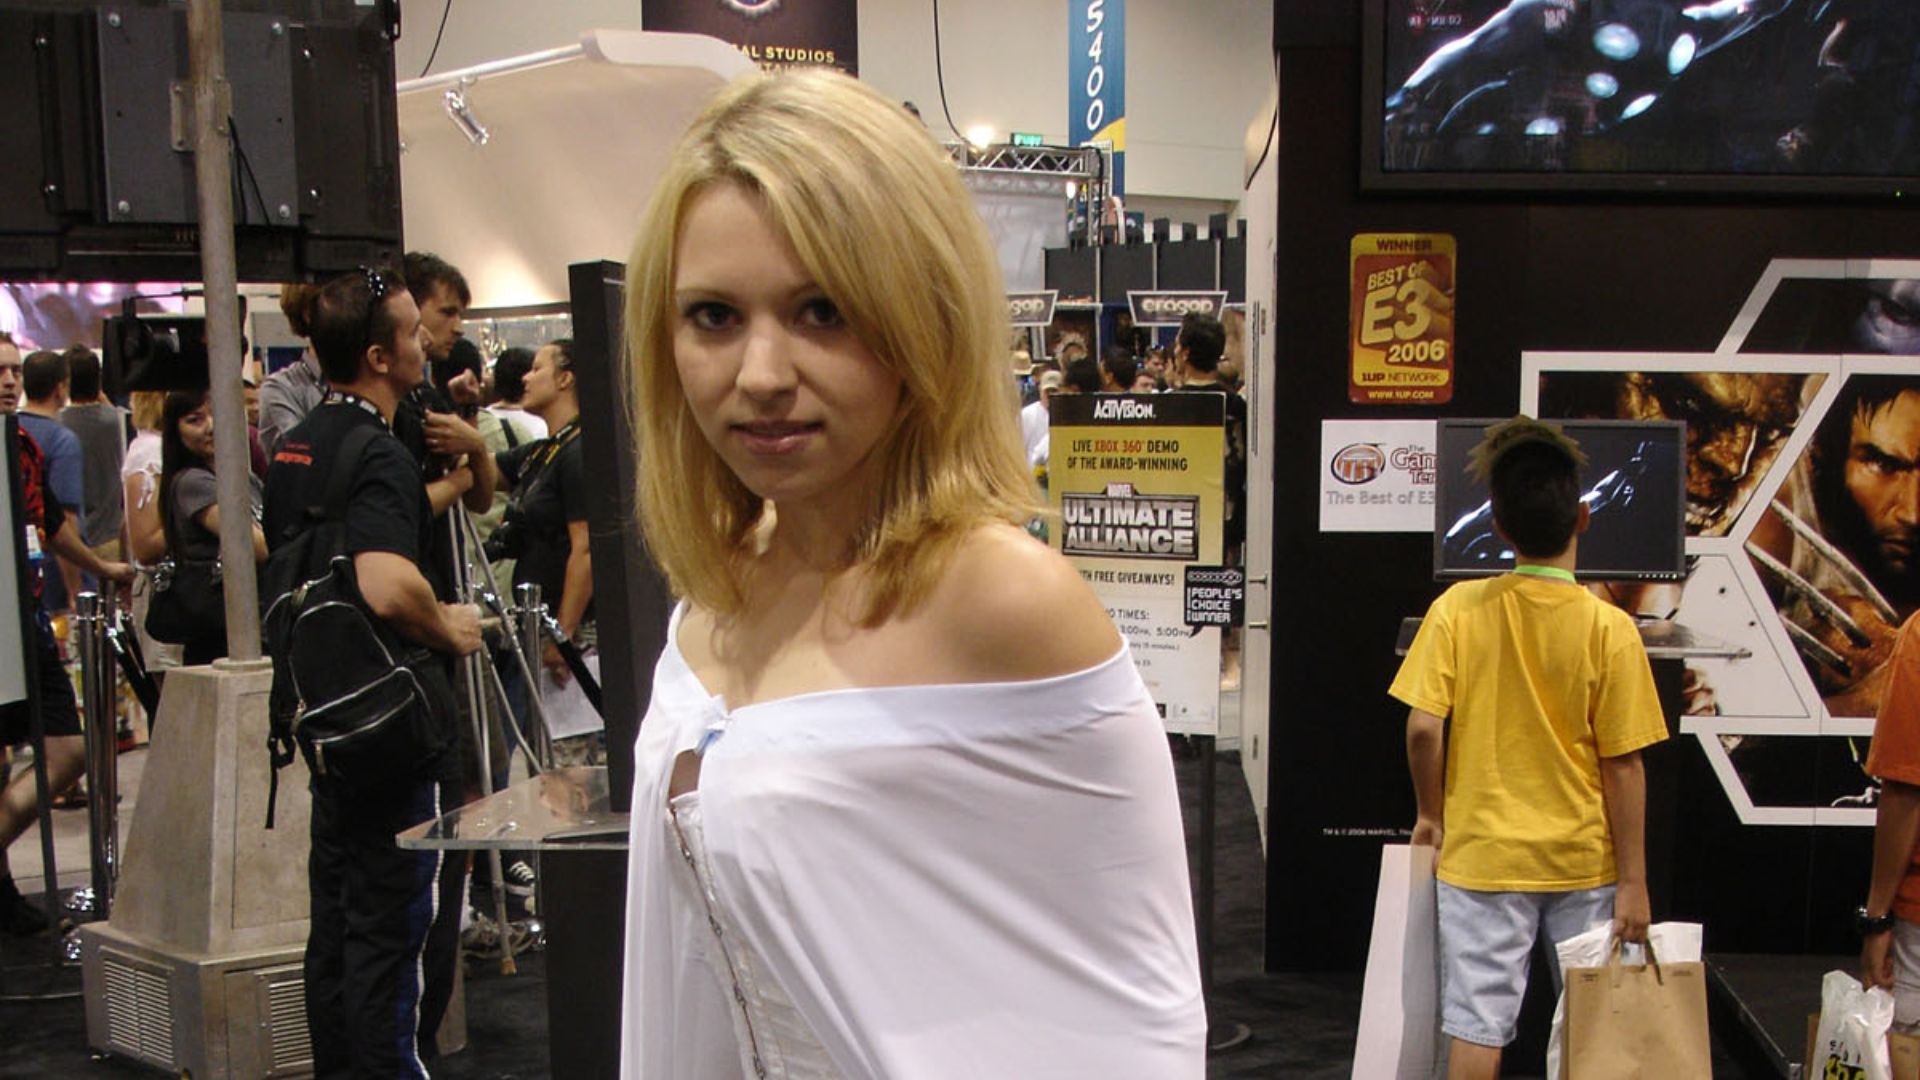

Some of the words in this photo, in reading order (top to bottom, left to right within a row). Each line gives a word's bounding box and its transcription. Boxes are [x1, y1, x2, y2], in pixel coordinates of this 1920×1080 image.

[766, 46, 836, 63] STUDIOS
[1376, 239, 1432, 251] WINNER
[1367, 265, 1406, 291] BEST
[1361, 279, 1432, 345] E3
[1387, 339, 1446, 362] 2006
[1362, 373, 1385, 382] 1UP
[1073, 440, 1092, 453] LIVE
[1094, 440, 1119, 453] XBOX
[1147, 440, 1180, 453] DEMO
[1067, 456, 1077, 468] OF
[1081, 457, 1097, 469] THE
[1100, 457, 1189, 471] AWARD-WINNING
[1326, 491, 1355, 504] The
[1359, 491, 1393, 504] Best
[1397, 491, 1413, 504] of
[1065, 499, 1194, 528] ULTIMATE
[1066, 525, 1195, 554] ALLIANCE
[1094, 570, 1114, 583] FREE
[1118, 572, 1175, 586] GIVEAWAYS!
[1191, 588, 1242, 600] PEOPLE'S
[1191, 599, 1231, 611] CHOICE
[1118, 609, 1150, 620] TIMES:
[1191, 611, 1231, 623] WINNER
